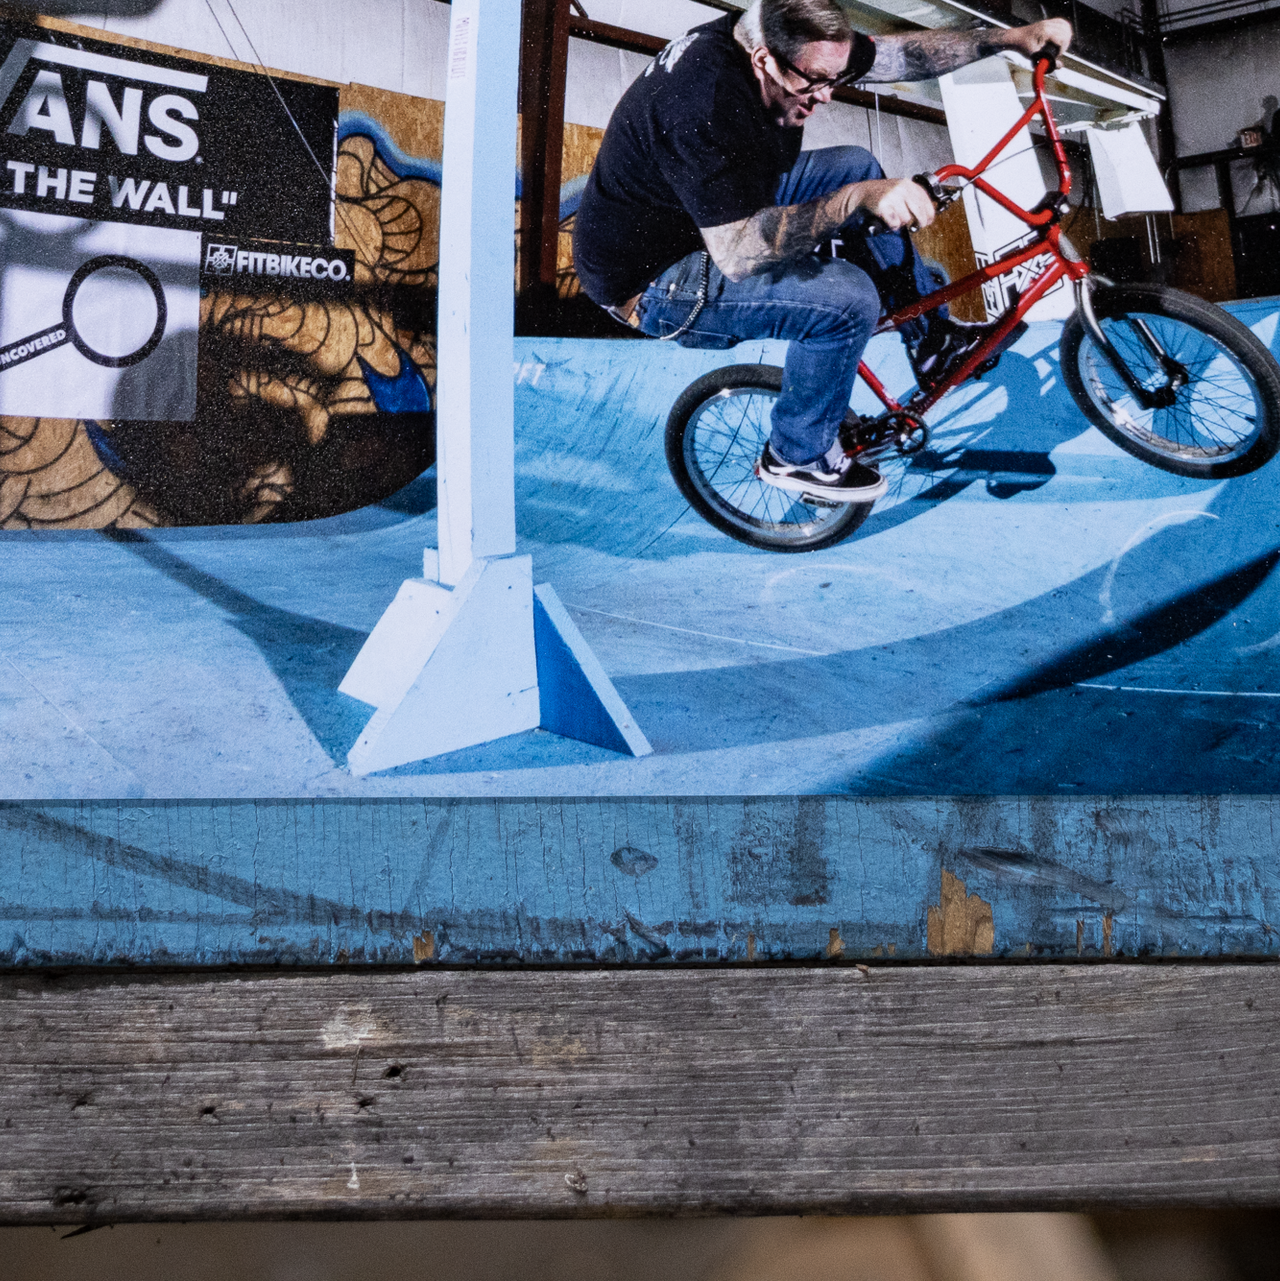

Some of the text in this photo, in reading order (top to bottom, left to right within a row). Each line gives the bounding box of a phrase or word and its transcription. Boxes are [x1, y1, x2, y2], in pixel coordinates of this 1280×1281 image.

[7, 160, 97, 204] THE
[108, 175, 238, 220] WALL"
[236, 250, 351, 282] FITBIKECO.
